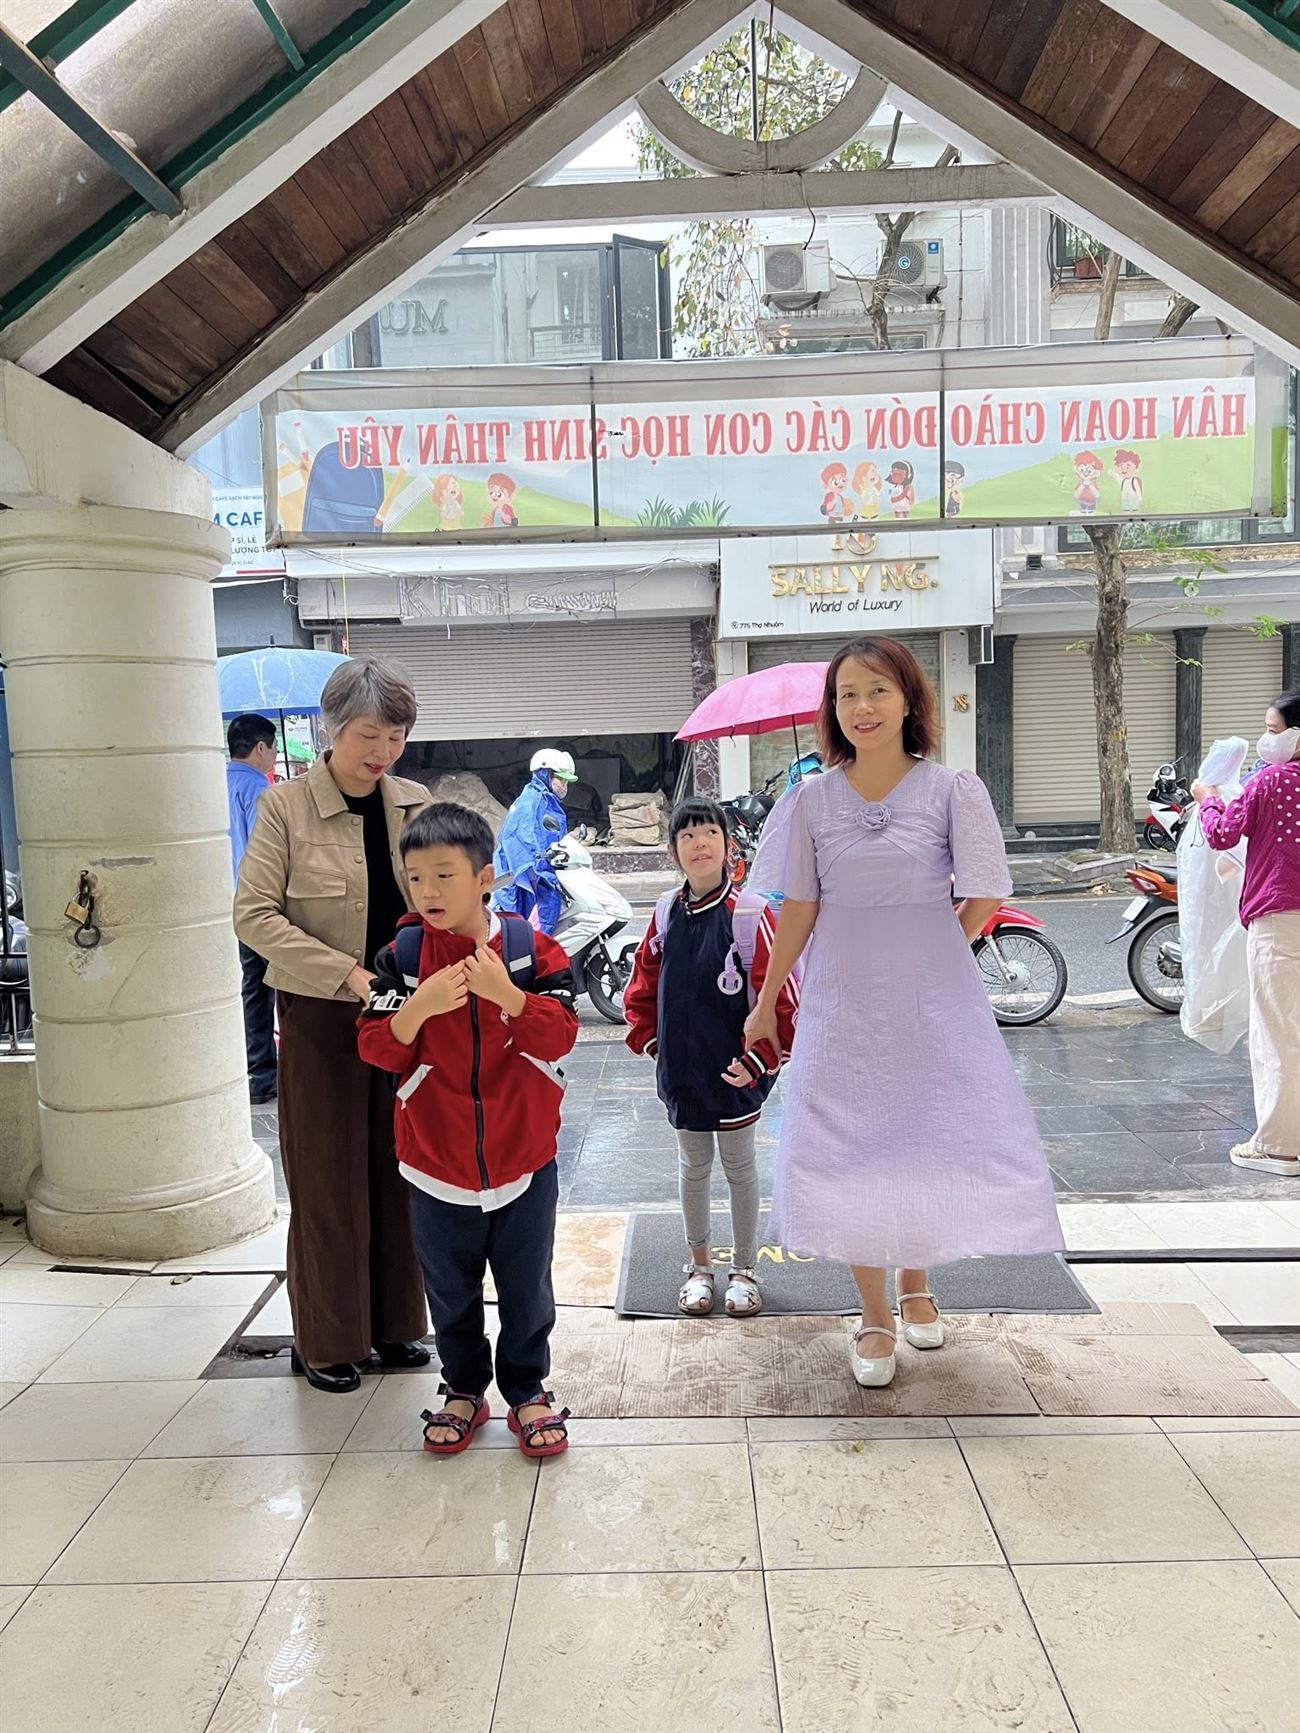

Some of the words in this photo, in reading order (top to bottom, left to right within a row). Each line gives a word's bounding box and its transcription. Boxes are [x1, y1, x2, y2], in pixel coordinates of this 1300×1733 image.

[771, 564, 872, 597] SALLY
[809, 600, 843, 614] World
[847, 599, 860, 612] of
[863, 599, 903, 612] Luxury
